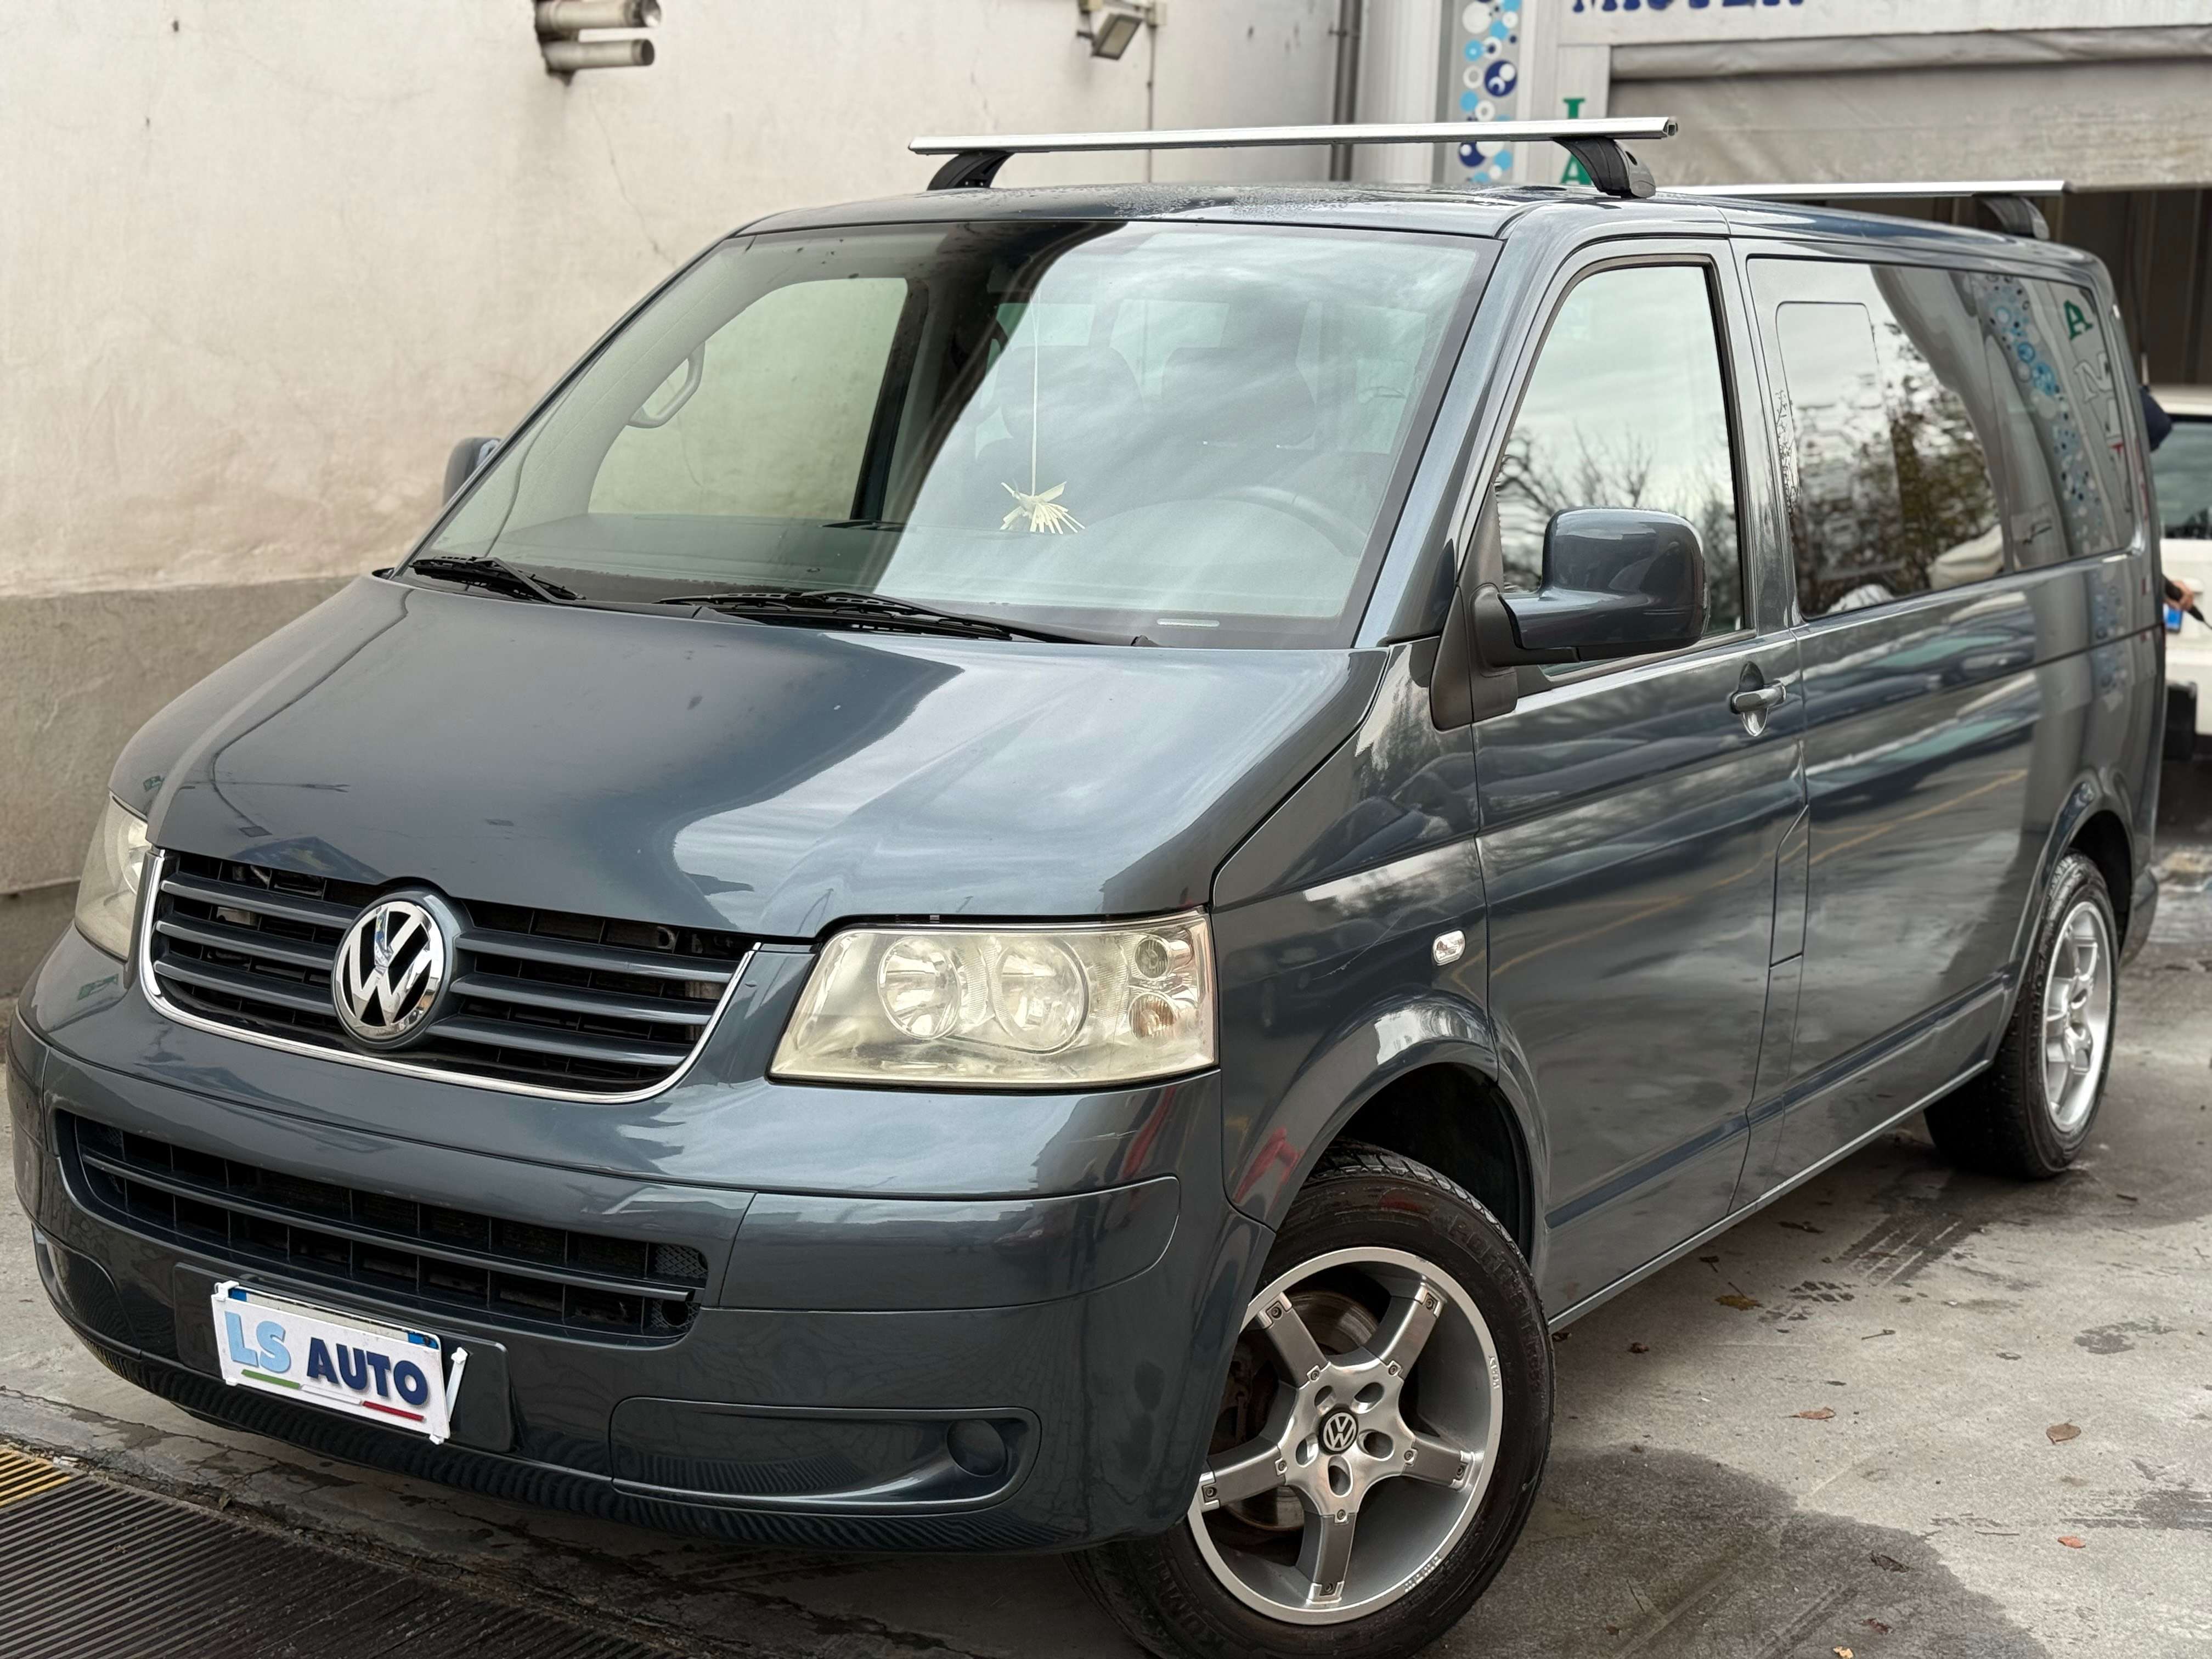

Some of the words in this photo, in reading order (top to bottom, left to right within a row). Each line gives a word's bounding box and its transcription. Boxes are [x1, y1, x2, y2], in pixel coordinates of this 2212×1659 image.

[333, 901, 445, 1039] VW
[225, 1311, 291, 1373] LS
[307, 1337, 429, 1406] AUTO
[1323, 1412, 1356, 1452] VW
